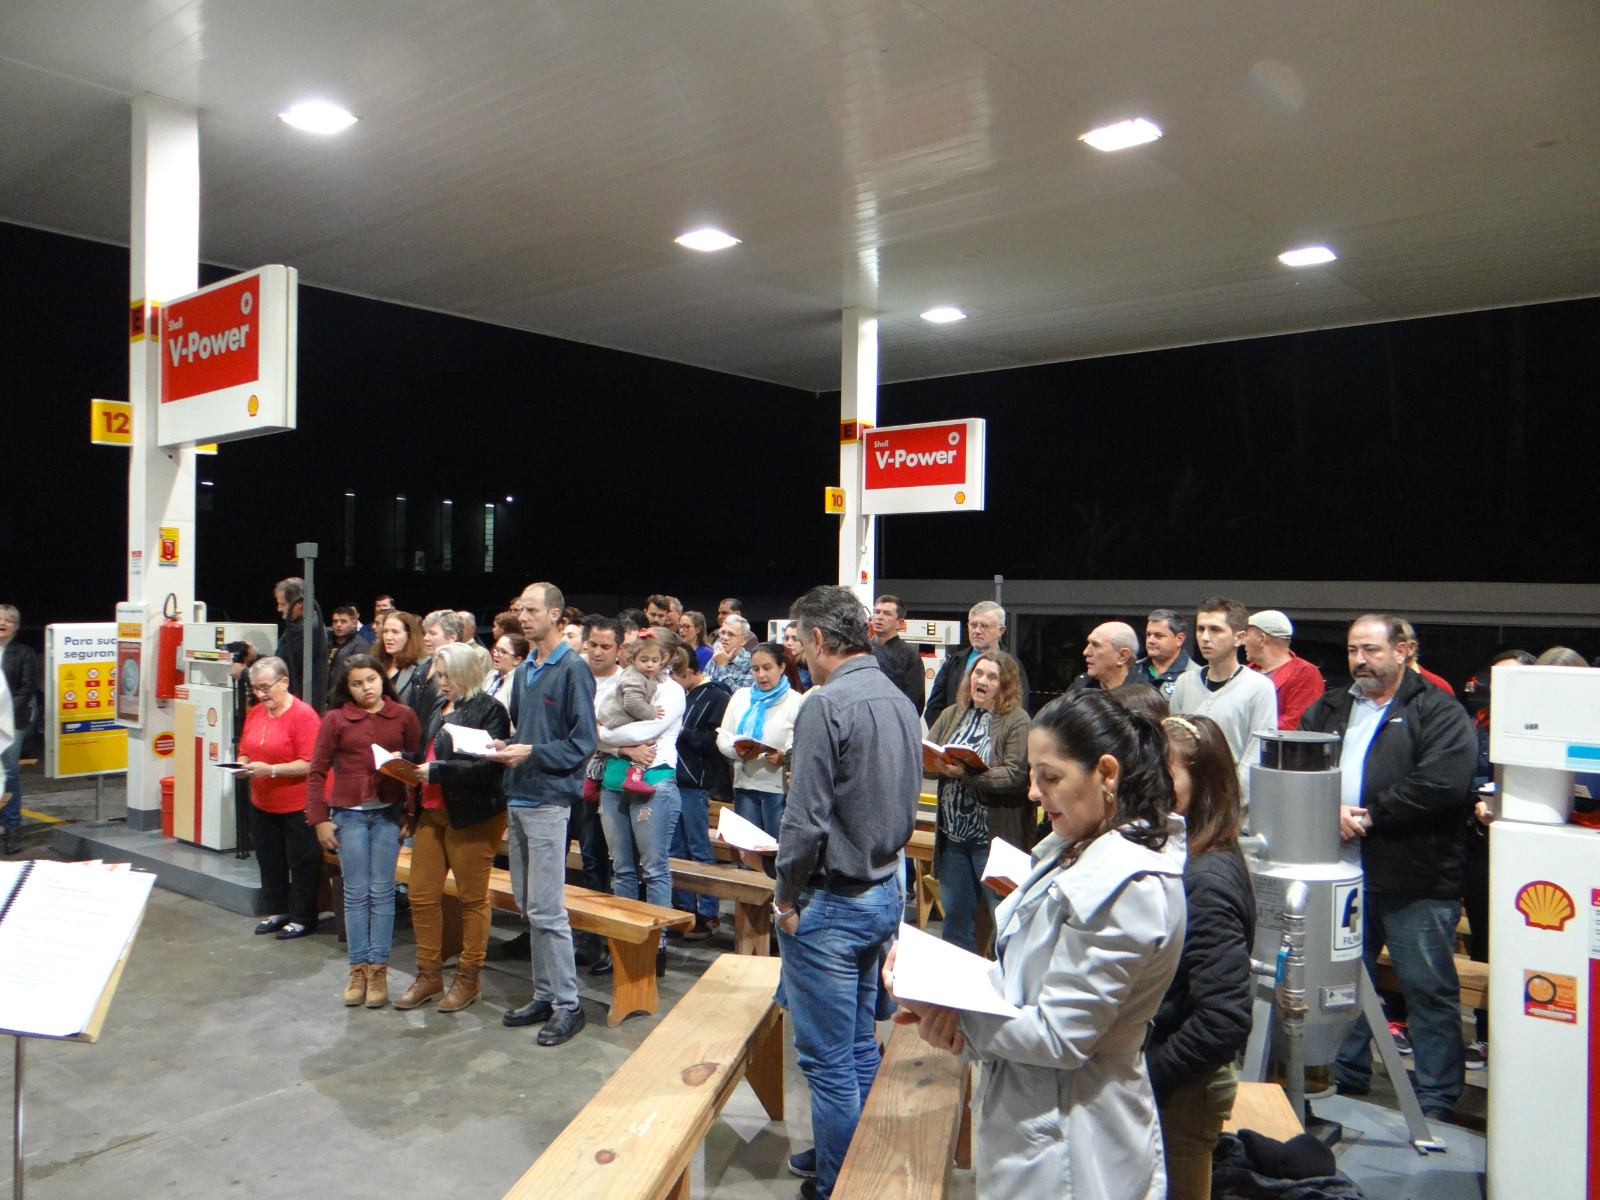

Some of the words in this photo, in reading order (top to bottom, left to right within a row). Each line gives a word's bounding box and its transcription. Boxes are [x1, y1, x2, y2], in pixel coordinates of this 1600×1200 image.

[168, 317, 183, 331] Shell
[169, 323, 250, 368] V-Power
[102, 411, 130, 434] 12
[873, 440, 889, 448] Shell
[875, 449, 957, 470] V-Power
[831, 493, 843, 507] 10
[64, 636, 93, 646] Para
[64, 650, 117, 660] seguran
